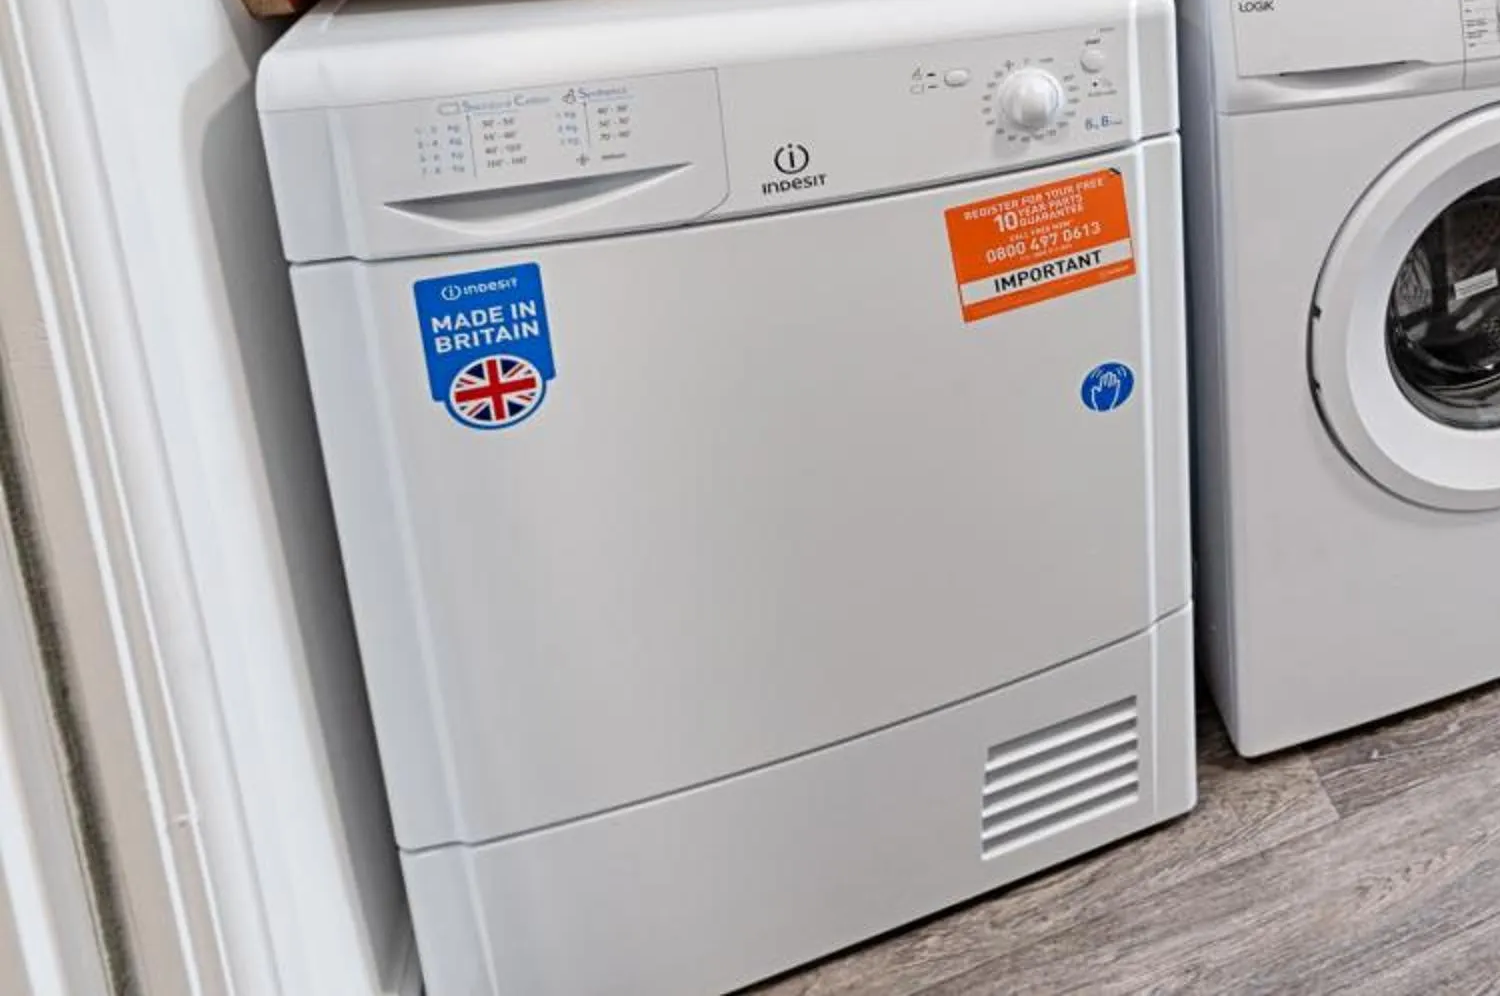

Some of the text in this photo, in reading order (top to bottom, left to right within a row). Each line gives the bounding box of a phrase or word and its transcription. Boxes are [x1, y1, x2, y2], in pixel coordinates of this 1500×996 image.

[963, 199, 1019, 221] REGISTER
[993, 211, 1019, 233] 10
[985, 241, 1026, 264] 0800
[1030, 232, 1058, 251] 497
[1063, 221, 1102, 243] 0613
[993, 249, 1102, 293] IMPORTANT
[430, 299, 538, 333] MADE IN
[434, 319, 541, 354] BRITAIN
